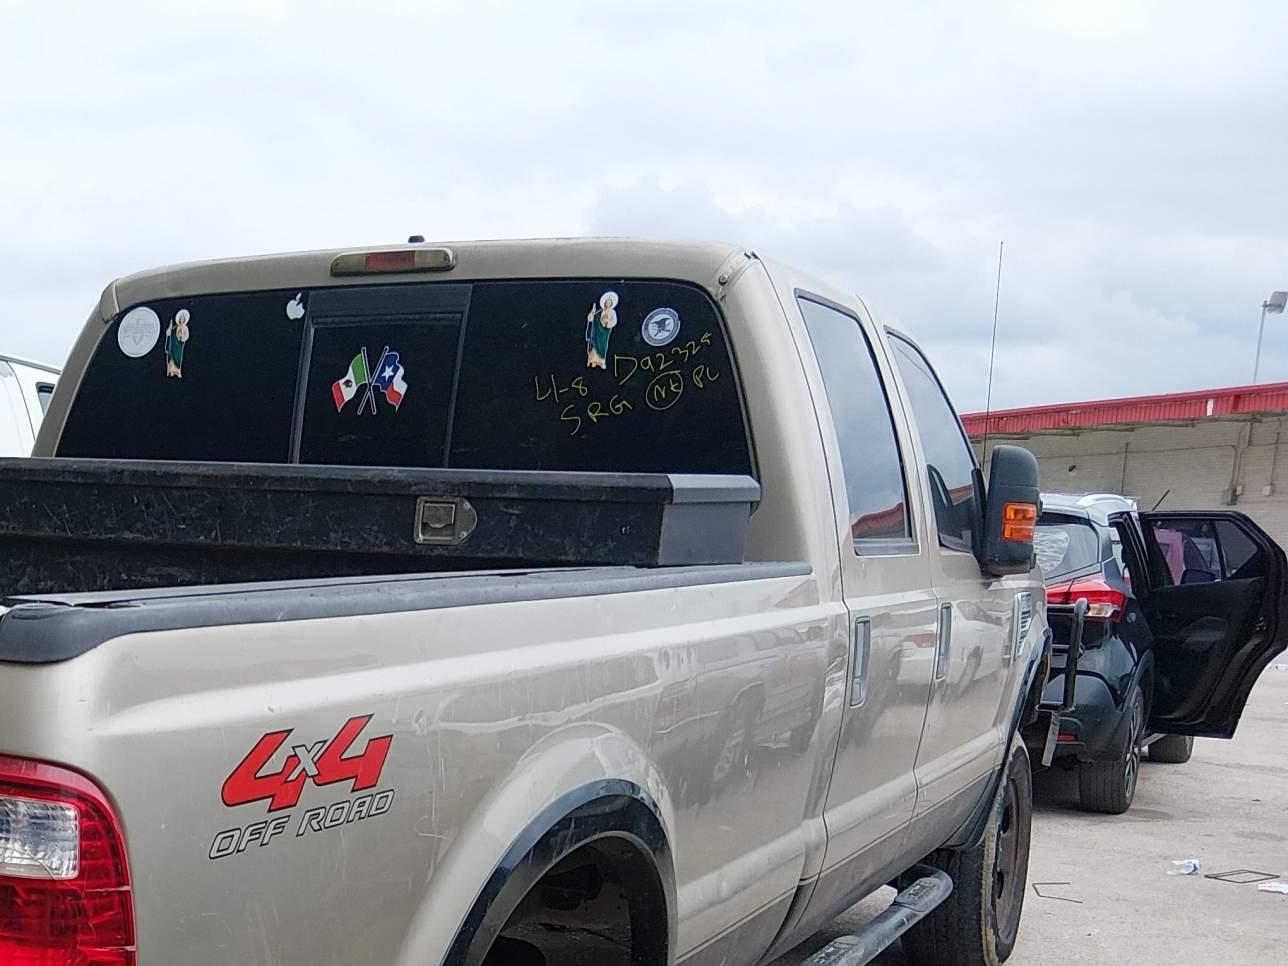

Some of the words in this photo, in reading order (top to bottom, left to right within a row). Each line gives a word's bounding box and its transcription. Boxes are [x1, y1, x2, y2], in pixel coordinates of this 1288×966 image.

[561, 395, 633, 435] SRG
[209, 814, 291, 859] OFF
[296, 788, 395, 836] ROAD
